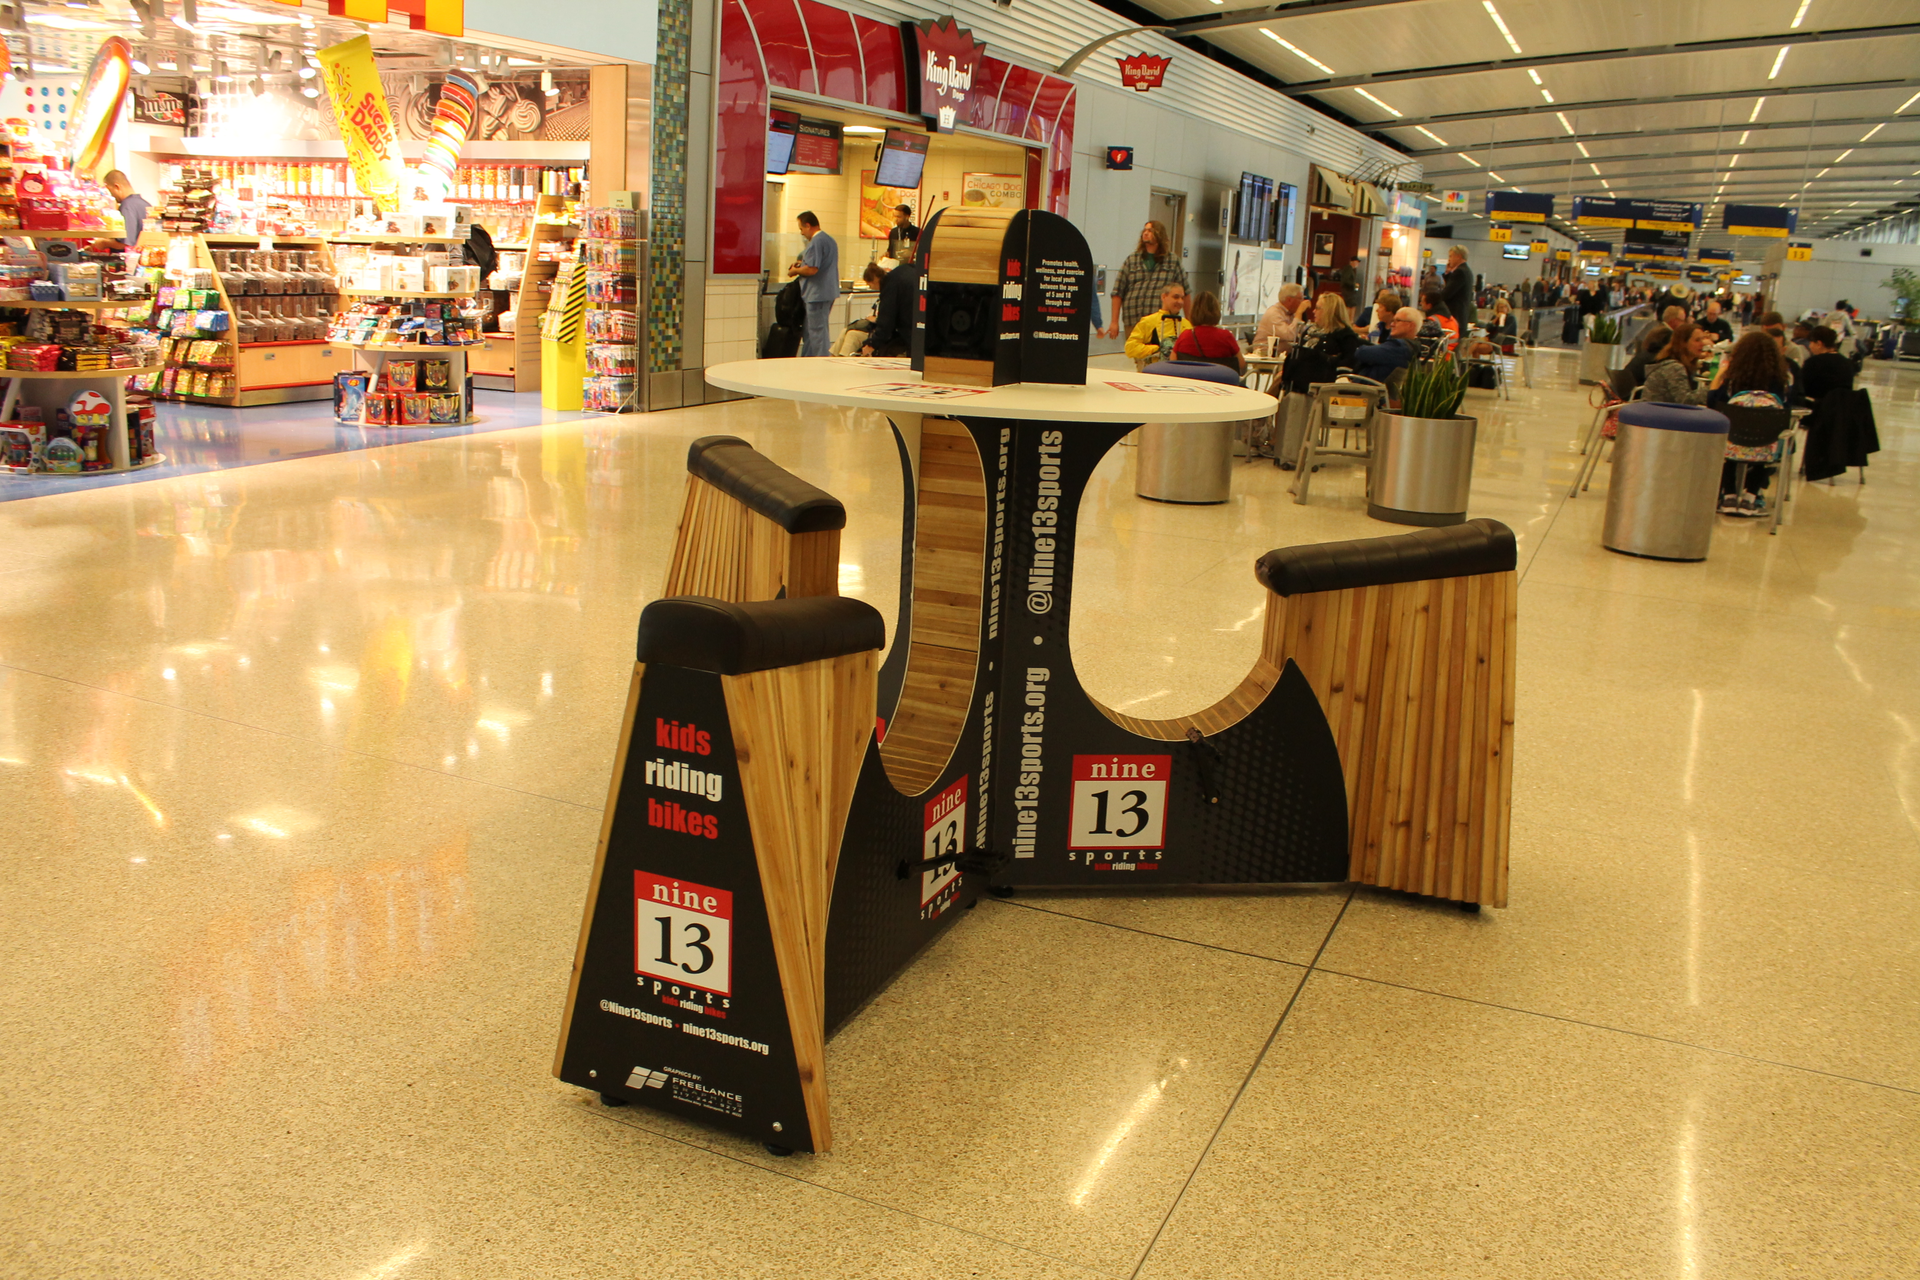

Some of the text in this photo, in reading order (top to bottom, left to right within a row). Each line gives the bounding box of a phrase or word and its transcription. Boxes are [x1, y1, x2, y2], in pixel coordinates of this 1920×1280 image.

[926, 49, 973, 96] King David
[1124, 64, 1160, 79] King David
[952, 88, 965, 102] Dogs
[360, 92, 393, 145] SUGAR
[350, 106, 391, 161] DADDY
[900, 190, 916, 198] DOG
[967, 180, 1022, 190] CHICAGO DOG
[990, 190, 1022, 199] COMBO
[1495, 232, 1506, 240] 14
[1006, 259, 1021, 276] kids
[1793, 250, 1805, 260] 13
[1002, 281, 1022, 300] riding
[1002, 304, 1020, 321] bikes
[1033, 331, 1078, 340] @Nine13sports
[976, 428, 1010, 850] Nine13sports nine13sports.org
[1012, 430, 1063, 859] nine13sports.org @Nine13sports
[656, 717, 711, 756] kids
[645, 758, 722, 802] riding
[1090, 757, 1156, 778] nine
[932, 788, 962, 823] nine
[1088, 790, 1150, 838] 13
[648, 797, 718, 840] bikes
[931, 820, 958, 884] 13
[1069, 850, 1162, 865] sports
[1112, 862, 1136, 871] riding
[652, 882, 718, 912] nine
[920, 877, 962, 920] sports
[654, 916, 714, 974] 13
[637, 976, 730, 1009] sports
[662, 995, 726, 1019] kids riding bikes
[600, 1000, 770, 1056] @Nine13sports nine13sports.org
[663, 1066, 692, 1078] GRAPHICS
[672, 1077, 743, 1102] FREELANCE
